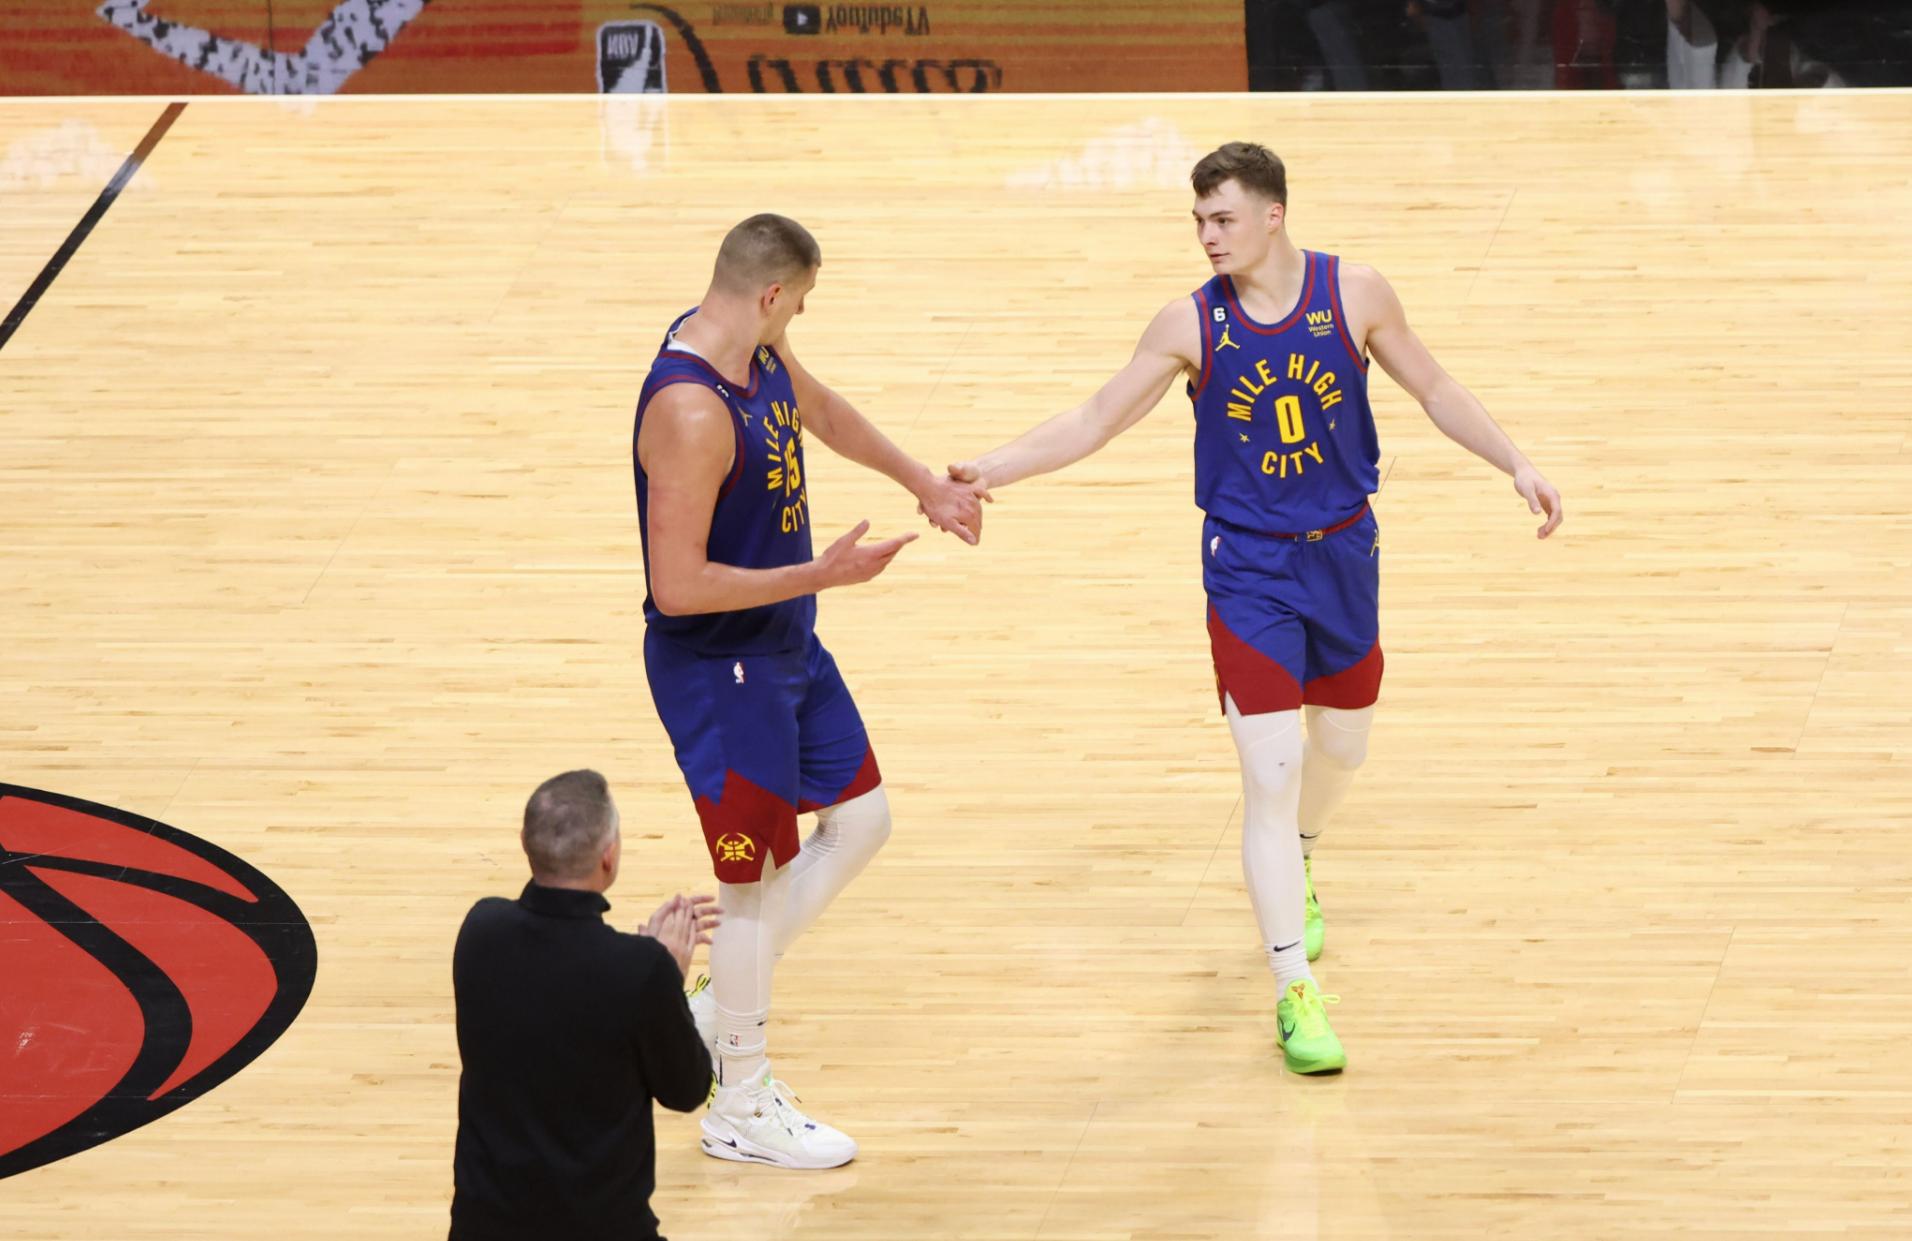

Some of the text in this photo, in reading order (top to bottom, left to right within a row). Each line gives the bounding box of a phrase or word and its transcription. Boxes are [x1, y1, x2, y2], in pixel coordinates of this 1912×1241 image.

[1213, 306, 1226, 323] 6
[1305, 309, 1333, 325] WU
[1227, 353, 1342, 422] MILE HIGH
[1275, 394, 1306, 444] 0
[763, 415, 784, 490] MILE
[784, 437, 801, 498] 15
[1261, 441, 1324, 478] CITY
